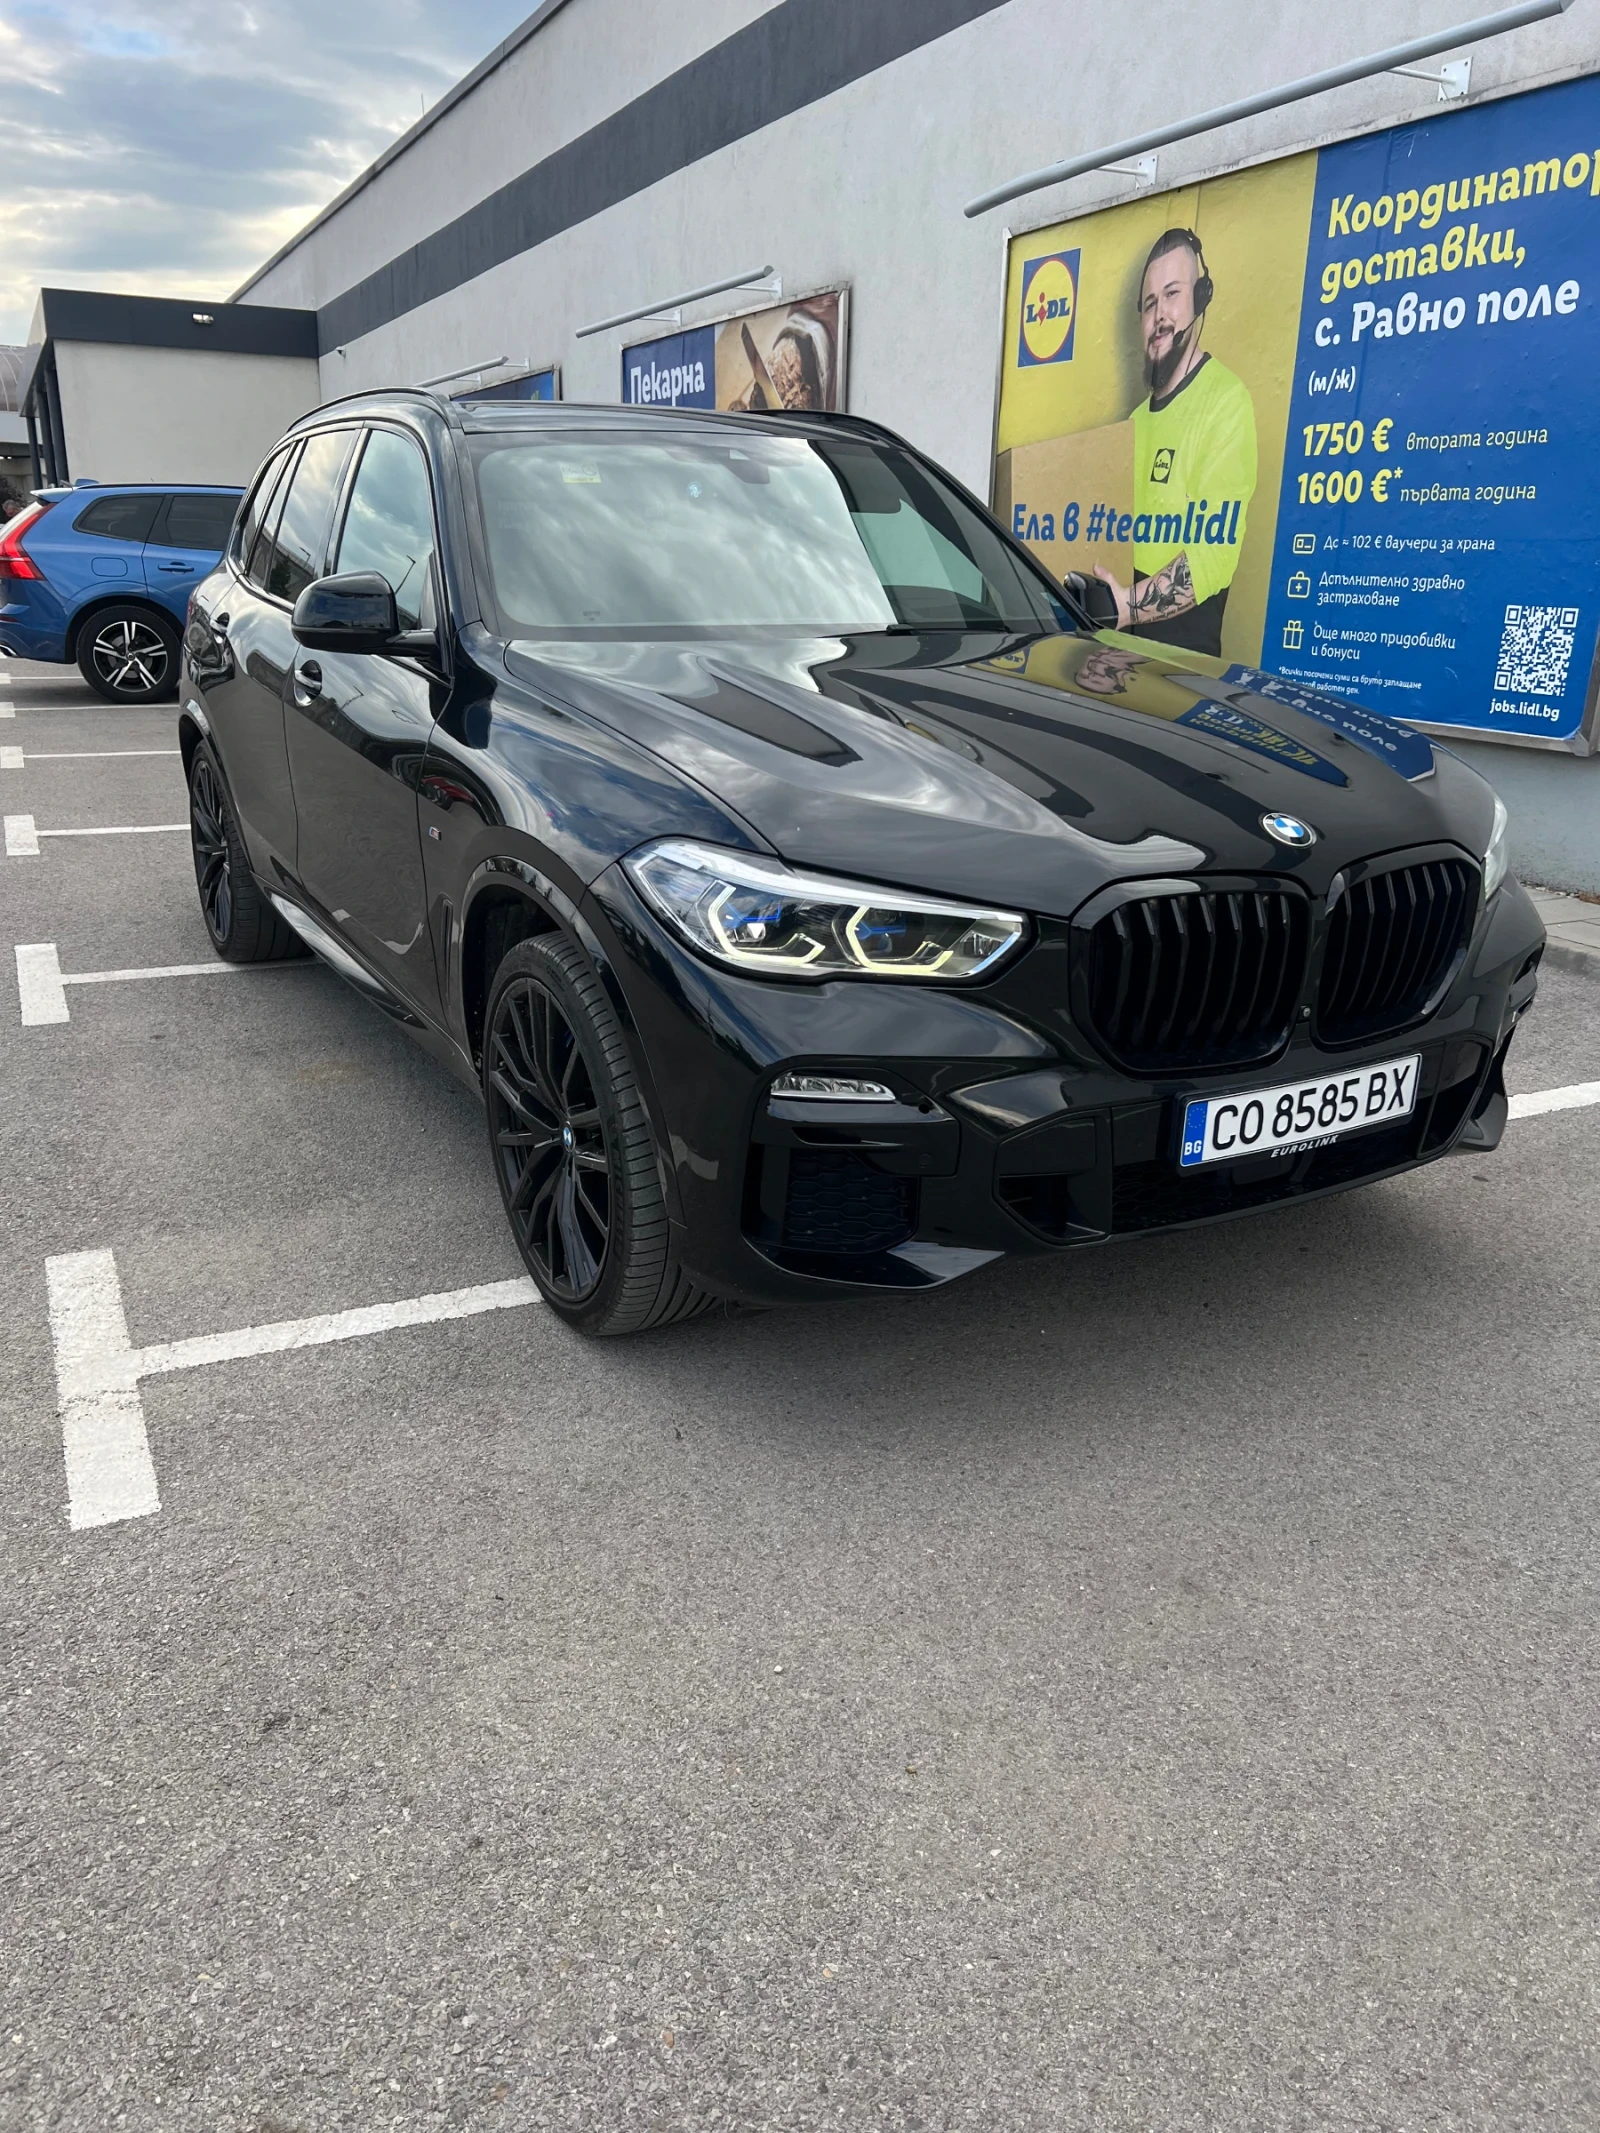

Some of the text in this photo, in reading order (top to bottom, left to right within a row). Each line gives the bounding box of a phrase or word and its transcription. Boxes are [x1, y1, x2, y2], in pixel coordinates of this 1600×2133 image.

[1320, 222, 1526, 304] доставки,
[1314, 279, 1580, 347] с. Равно поле
[630, 361, 706, 407] Пекарна
[1308, 366, 1356, 396] (м/ж)
[1303, 417, 1548, 457] 1750 € втората година
[1297, 470, 1363, 505] 1600
[1400, 483, 1470, 506] първата
[1475, 485, 1536, 505] година
[1012, 499, 1241, 545] Ела в #teamlidl
[1352, 535, 1372, 549] 102
[1374, 535, 1383, 549] €
[1385, 534, 1437, 553] ваучери
[1439, 538, 1453, 553] за
[1456, 538, 1495, 553] храна
[1318, 571, 1465, 592] Допълнително здравно
[1316, 591, 1400, 607] застраховане
[1311, 643, 1361, 661] и бонуси
[1340, 629, 1377, 643] много
[1380, 631, 1456, 650] придобивки
[1489, 699, 1560, 722] jobs.lidl.bg
[1212, 1064, 1411, 1150] CO 8585 BX
[1184, 1140, 1202, 1156] BG
[1270, 1134, 1340, 1158] EUROLINK
